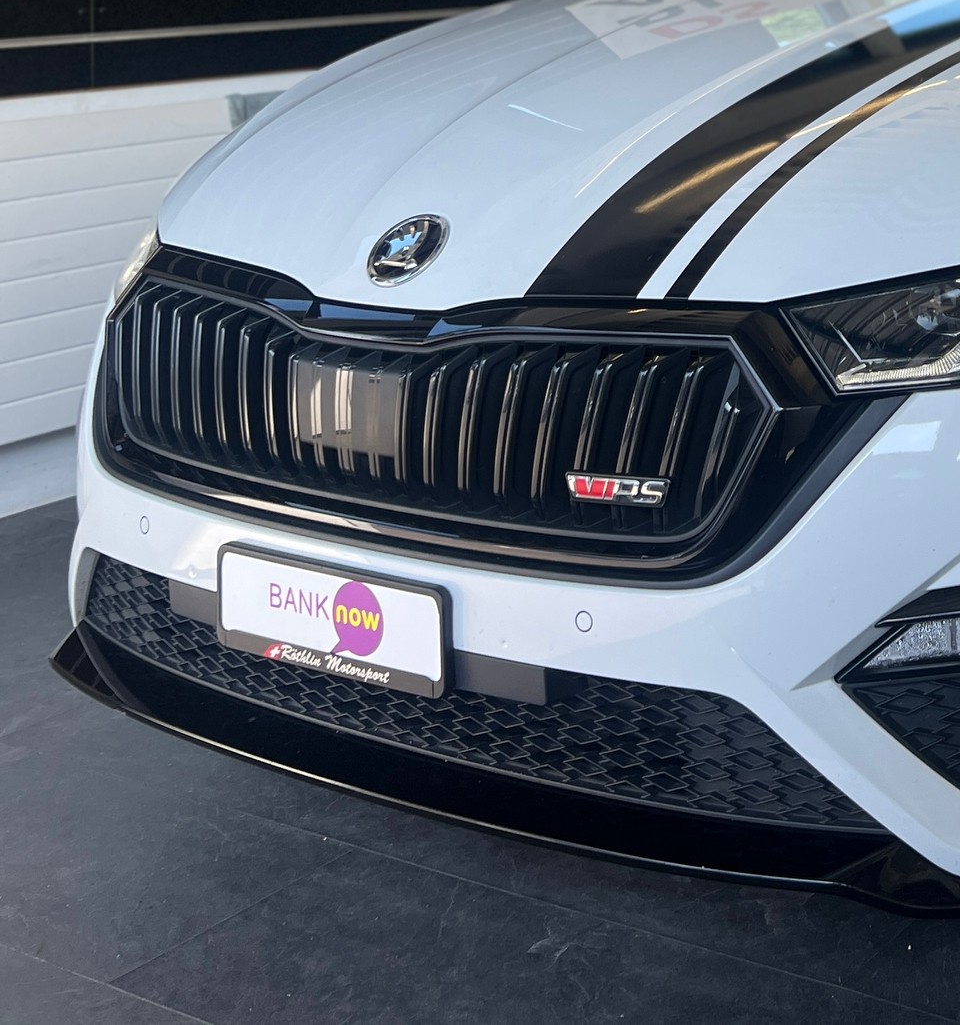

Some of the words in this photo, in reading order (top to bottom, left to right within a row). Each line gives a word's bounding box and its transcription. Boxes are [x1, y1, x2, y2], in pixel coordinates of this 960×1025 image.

[269, 582, 330, 621] BANK
[336, 604, 380, 632] now
[280, 644, 321, 668] Röthlin
[325, 655, 390, 684] Motorsport
